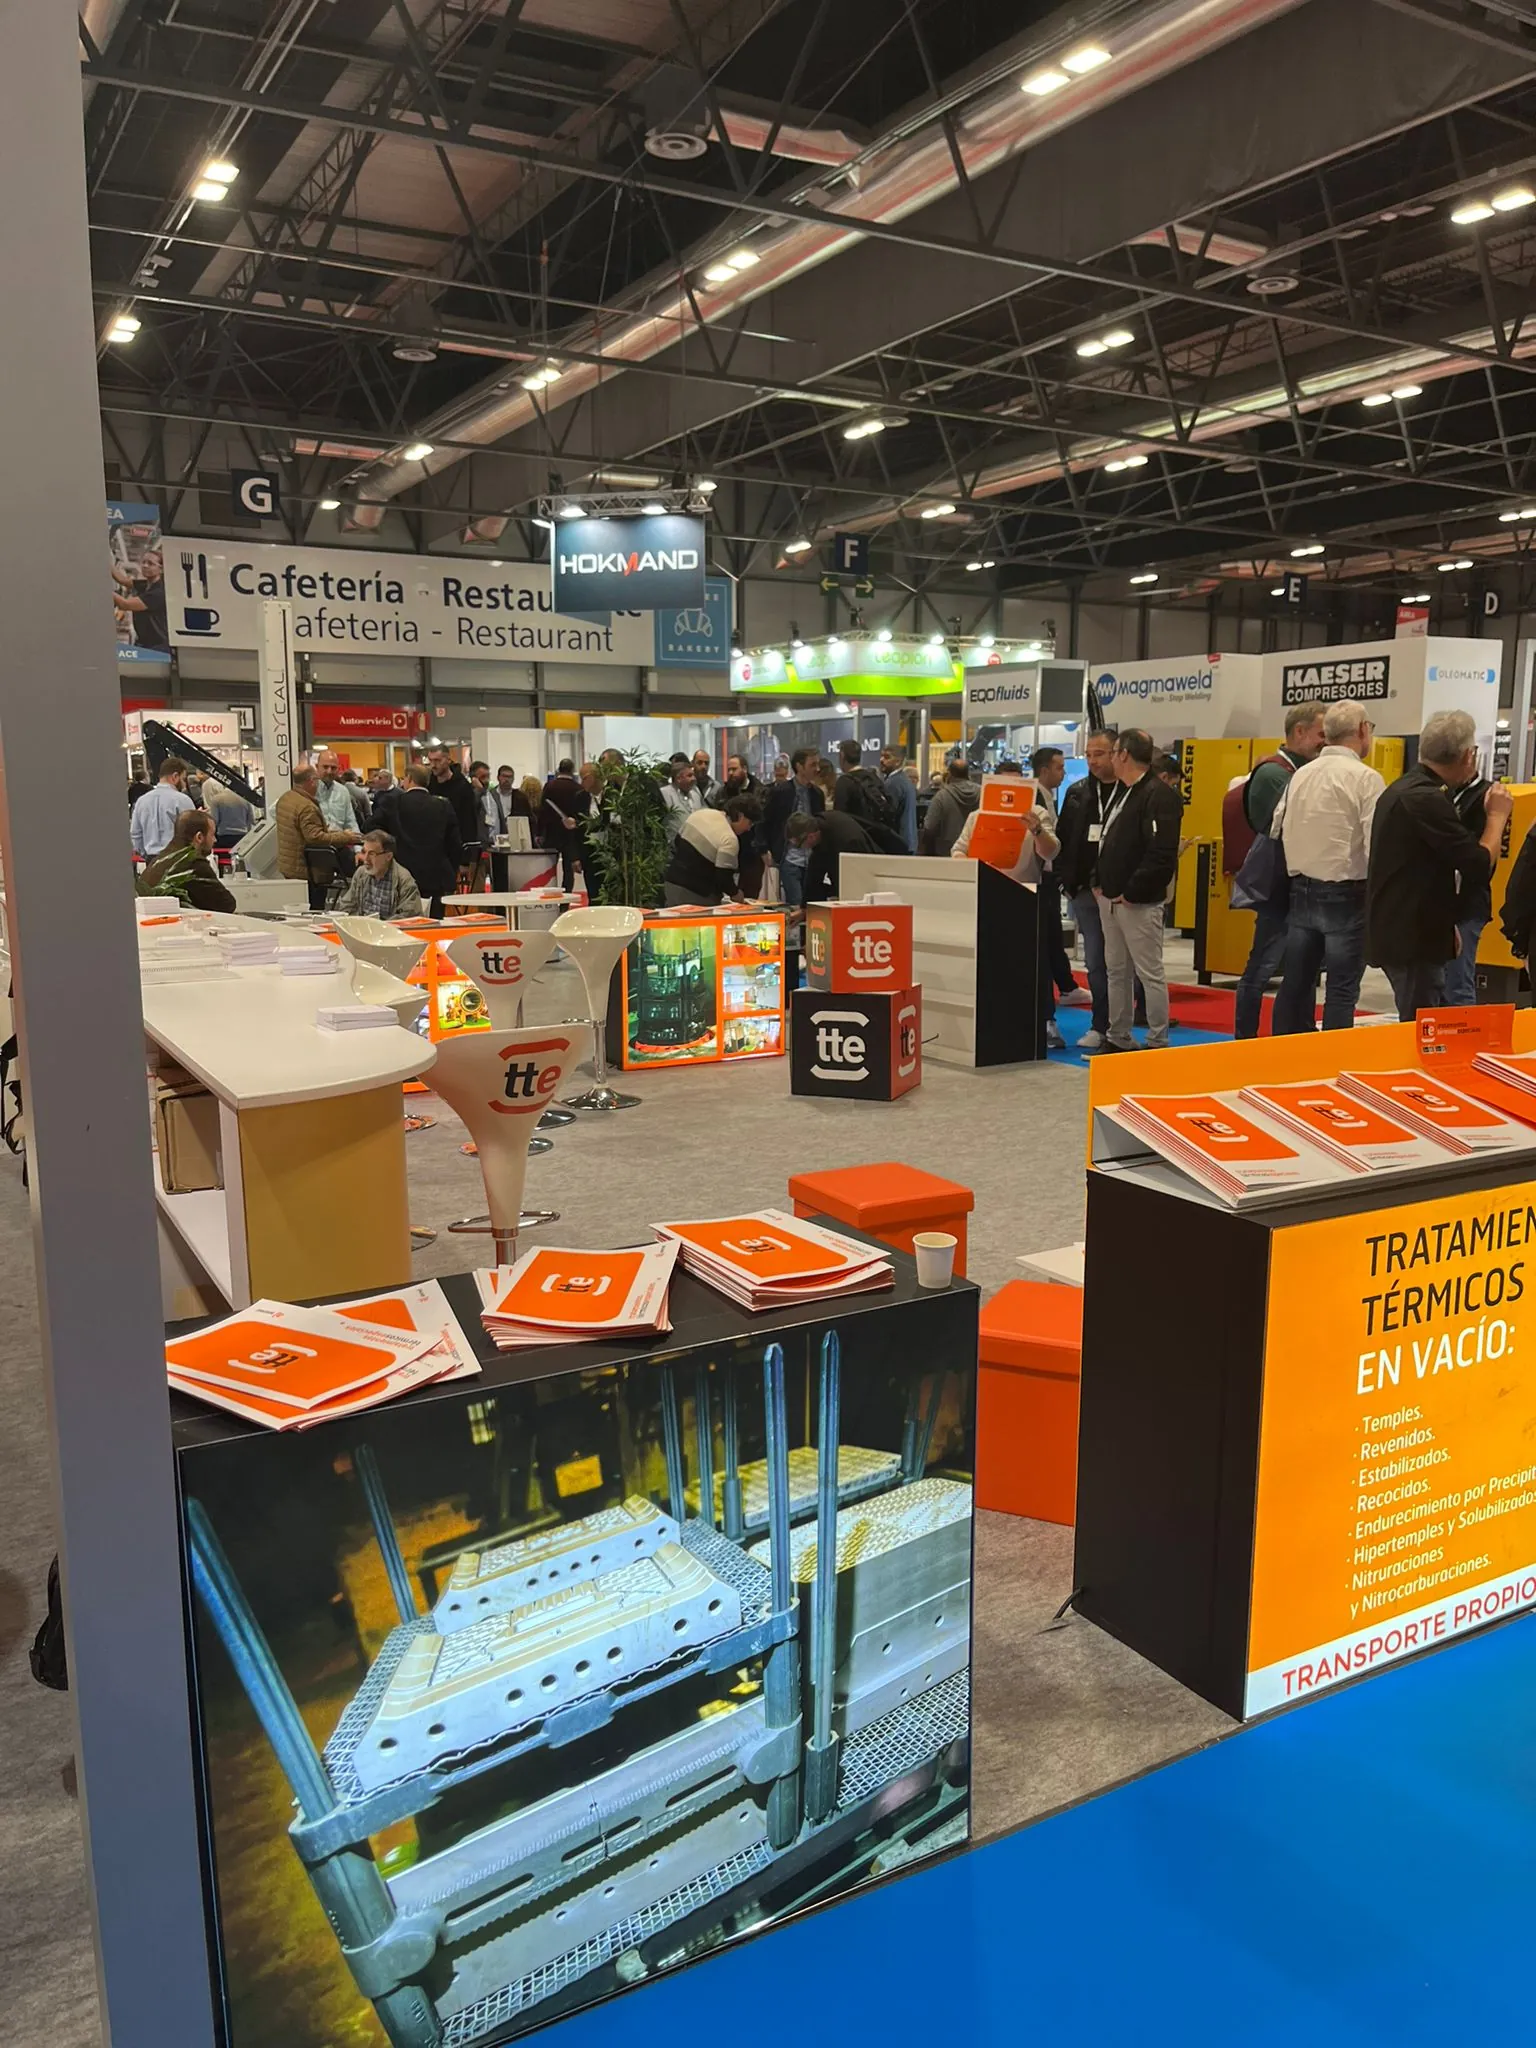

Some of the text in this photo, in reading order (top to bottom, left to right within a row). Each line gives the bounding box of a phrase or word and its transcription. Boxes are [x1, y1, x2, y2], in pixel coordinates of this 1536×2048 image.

[241, 477, 273, 514] G
[560, 550, 698, 576] HOKMAND
[844, 539, 858, 568] F
[229, 563, 404, 603] Cafetería
[1289, 578, 1300, 602] E
[1484, 591, 1498, 615] D
[295, 607, 418, 642] afeteria
[458, 617, 613, 652] Restaurant
[1286, 682, 1384, 702] COMPRESORES
[1287, 661, 1385, 688] KAESER
[177, 722, 223, 734] Castrol
[339, 715, 392, 726] Autoservicio
[1183, 745, 1194, 806] KAESER
[481, 951, 522, 975] tte
[852, 935, 892, 964] tte
[816, 1027, 866, 1064] tte
[504, 1060, 562, 1099] tte
[1362, 1262, 1525, 1336] TÉRMICOS
[1356, 1315, 1516, 1395] EN VACÍO:
[1362, 1405, 1424, 1434] Temples.
[1360, 1426, 1436, 1460] Revenidos.
[1358, 1446, 1451, 1487] Estabilizados.
[1355, 1492, 1461, 1539] Endurecimiento
[1464, 1484, 1486, 1507] por
[1356, 1477, 1431, 1513] Recocidos.
[1353, 1518, 1444, 1565] Hipertemples
[1447, 1517, 1455, 1536] y
[1350, 1553, 1492, 1619] y Nitrocarburaciones.
[1352, 1546, 1444, 1590] Nitruraciones
[1282, 1577, 1536, 1695] TRANSPORTE PROPIO
